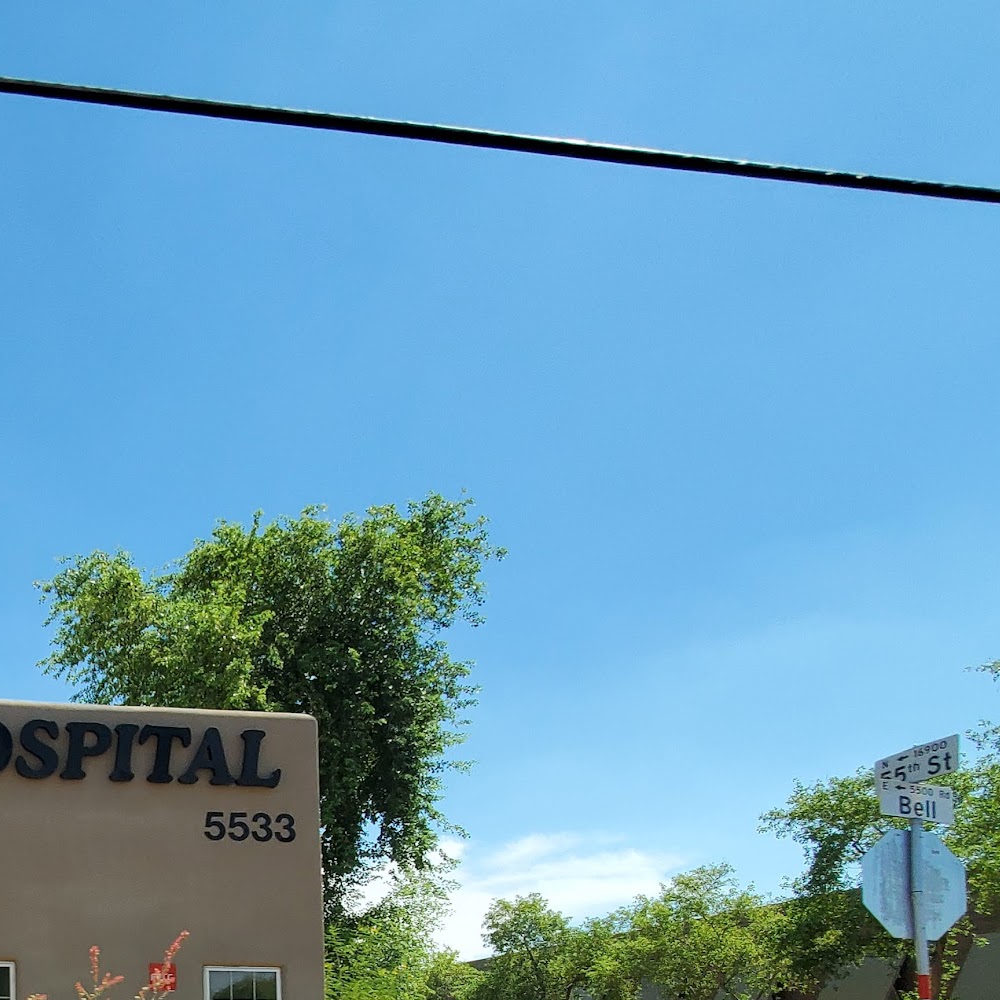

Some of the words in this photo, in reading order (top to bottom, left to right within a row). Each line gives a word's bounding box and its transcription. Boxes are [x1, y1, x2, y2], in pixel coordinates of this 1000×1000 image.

[882, 761, 889, 769] N
[927, 752, 953, 775] St
[882, 781, 889, 790] E
[899, 795, 936, 819] Bell
[204, 811, 297, 843] 5533
